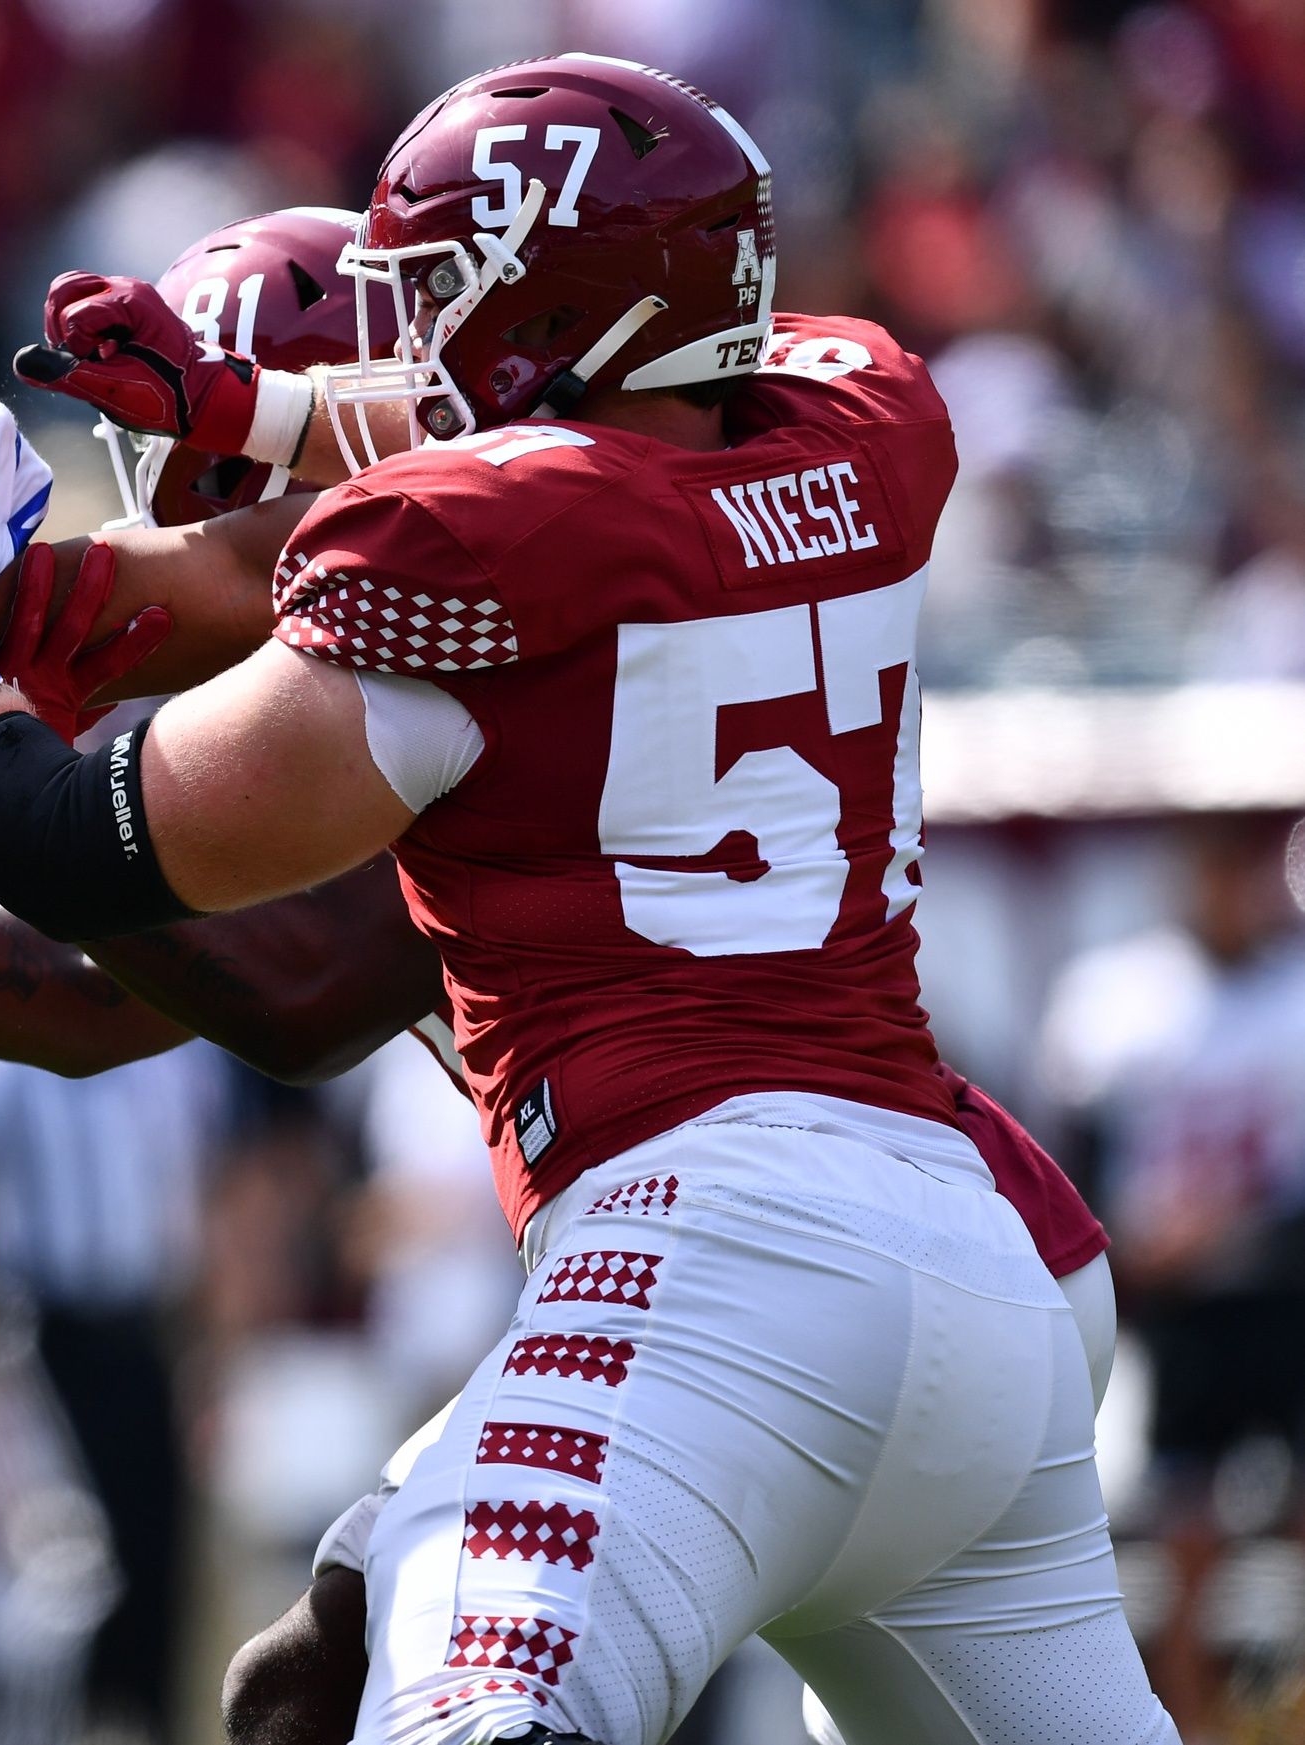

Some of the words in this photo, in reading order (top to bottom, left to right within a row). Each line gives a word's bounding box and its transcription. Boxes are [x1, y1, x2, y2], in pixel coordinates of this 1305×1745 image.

[471, 124, 601, 229] 57
[181, 273, 265, 364] 81
[711, 461, 879, 569] NIESE
[598, 560, 925, 957] 57
[520, 1099, 536, 1127] XL
